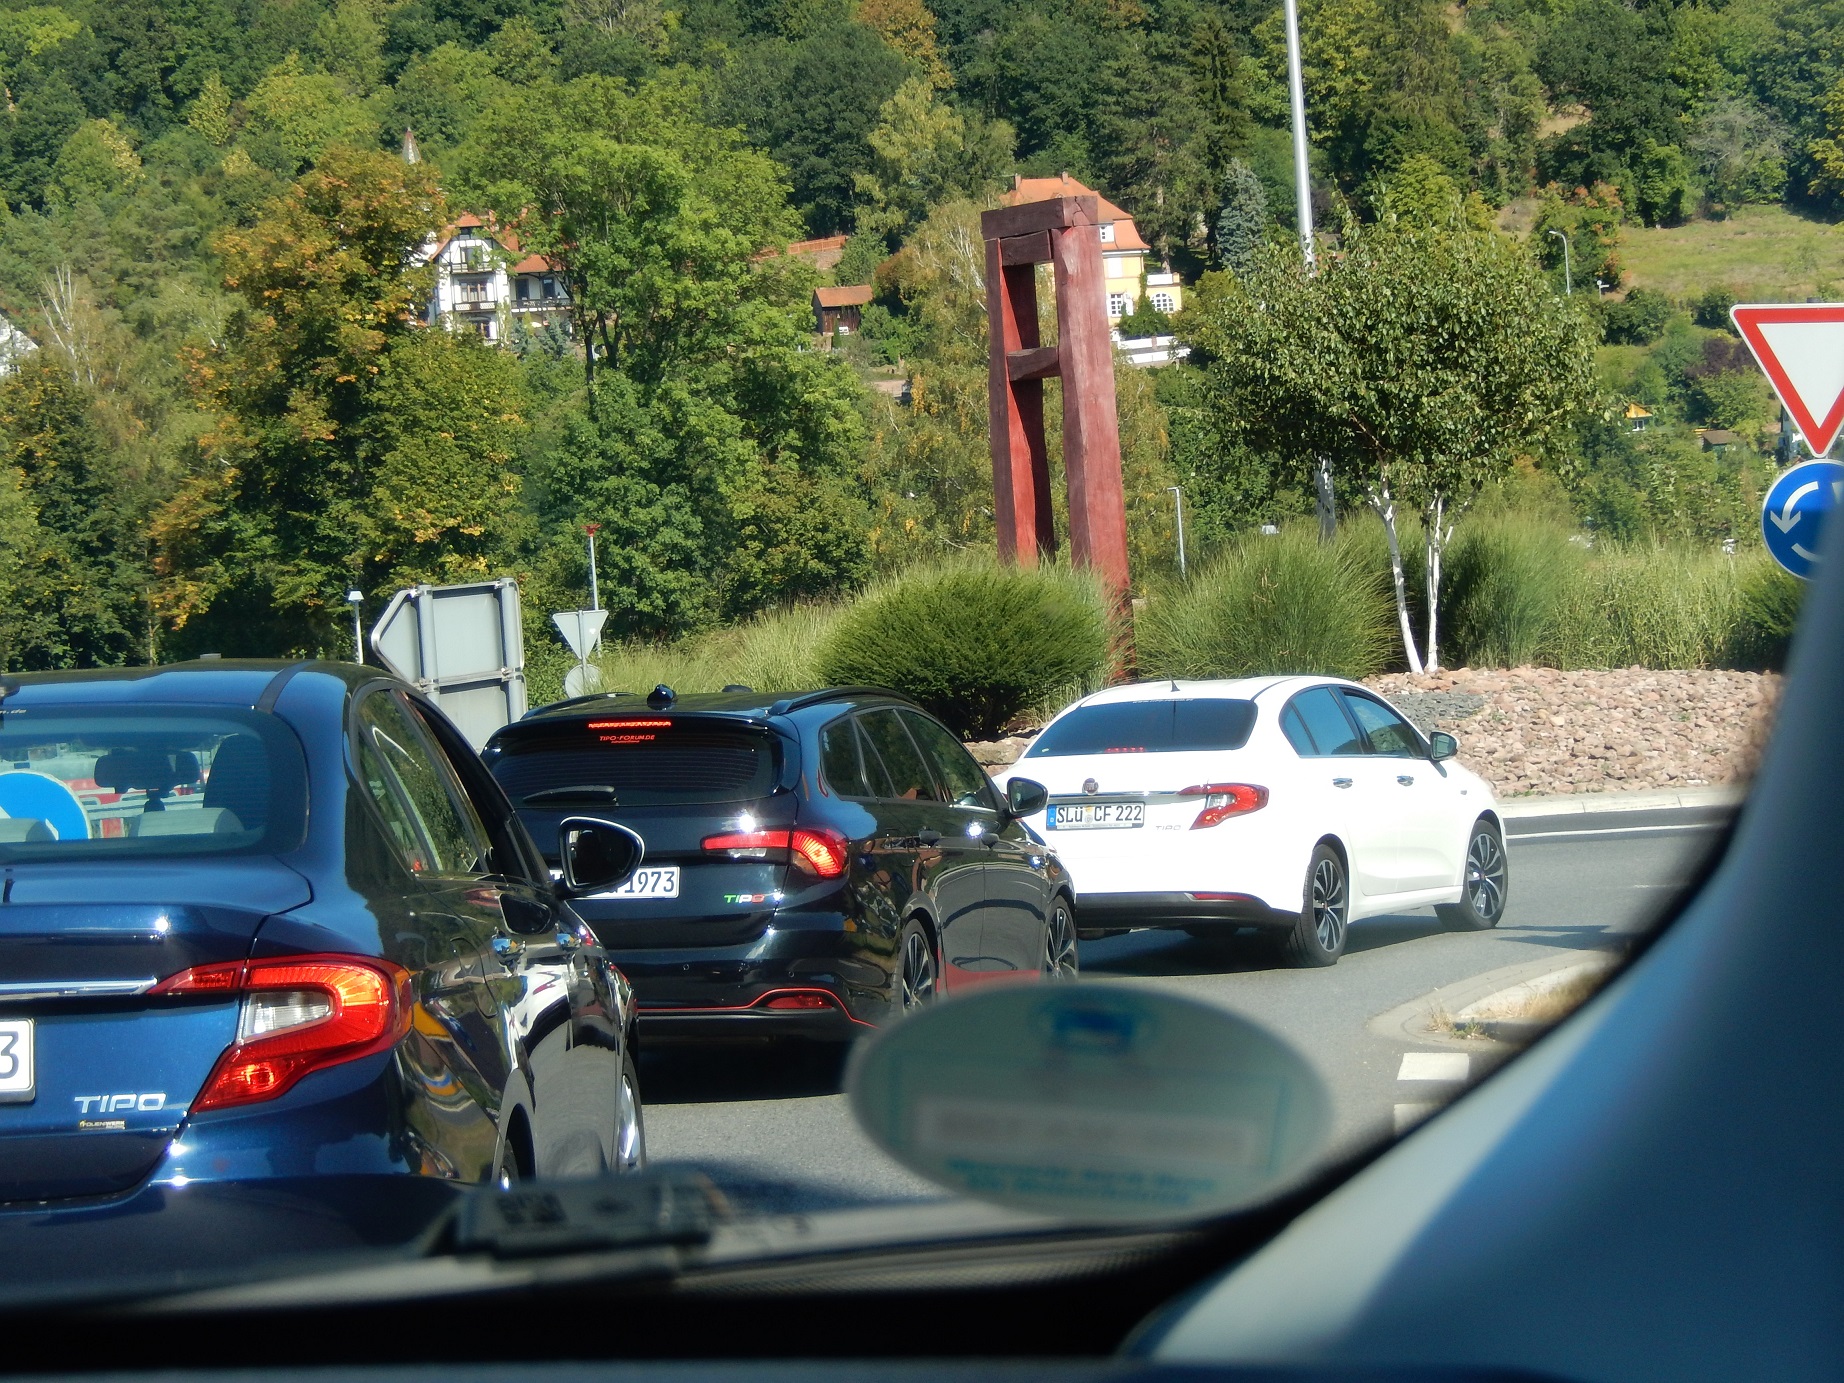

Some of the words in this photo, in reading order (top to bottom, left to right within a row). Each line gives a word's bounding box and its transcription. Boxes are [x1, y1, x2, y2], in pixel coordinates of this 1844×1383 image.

[1094, 806, 1112, 822] CF
[1115, 805, 1142, 821] 222
[624, 871, 675, 893] 1973
[723, 894, 766, 904] TIPO
[74, 1093, 166, 1114] TIPO
